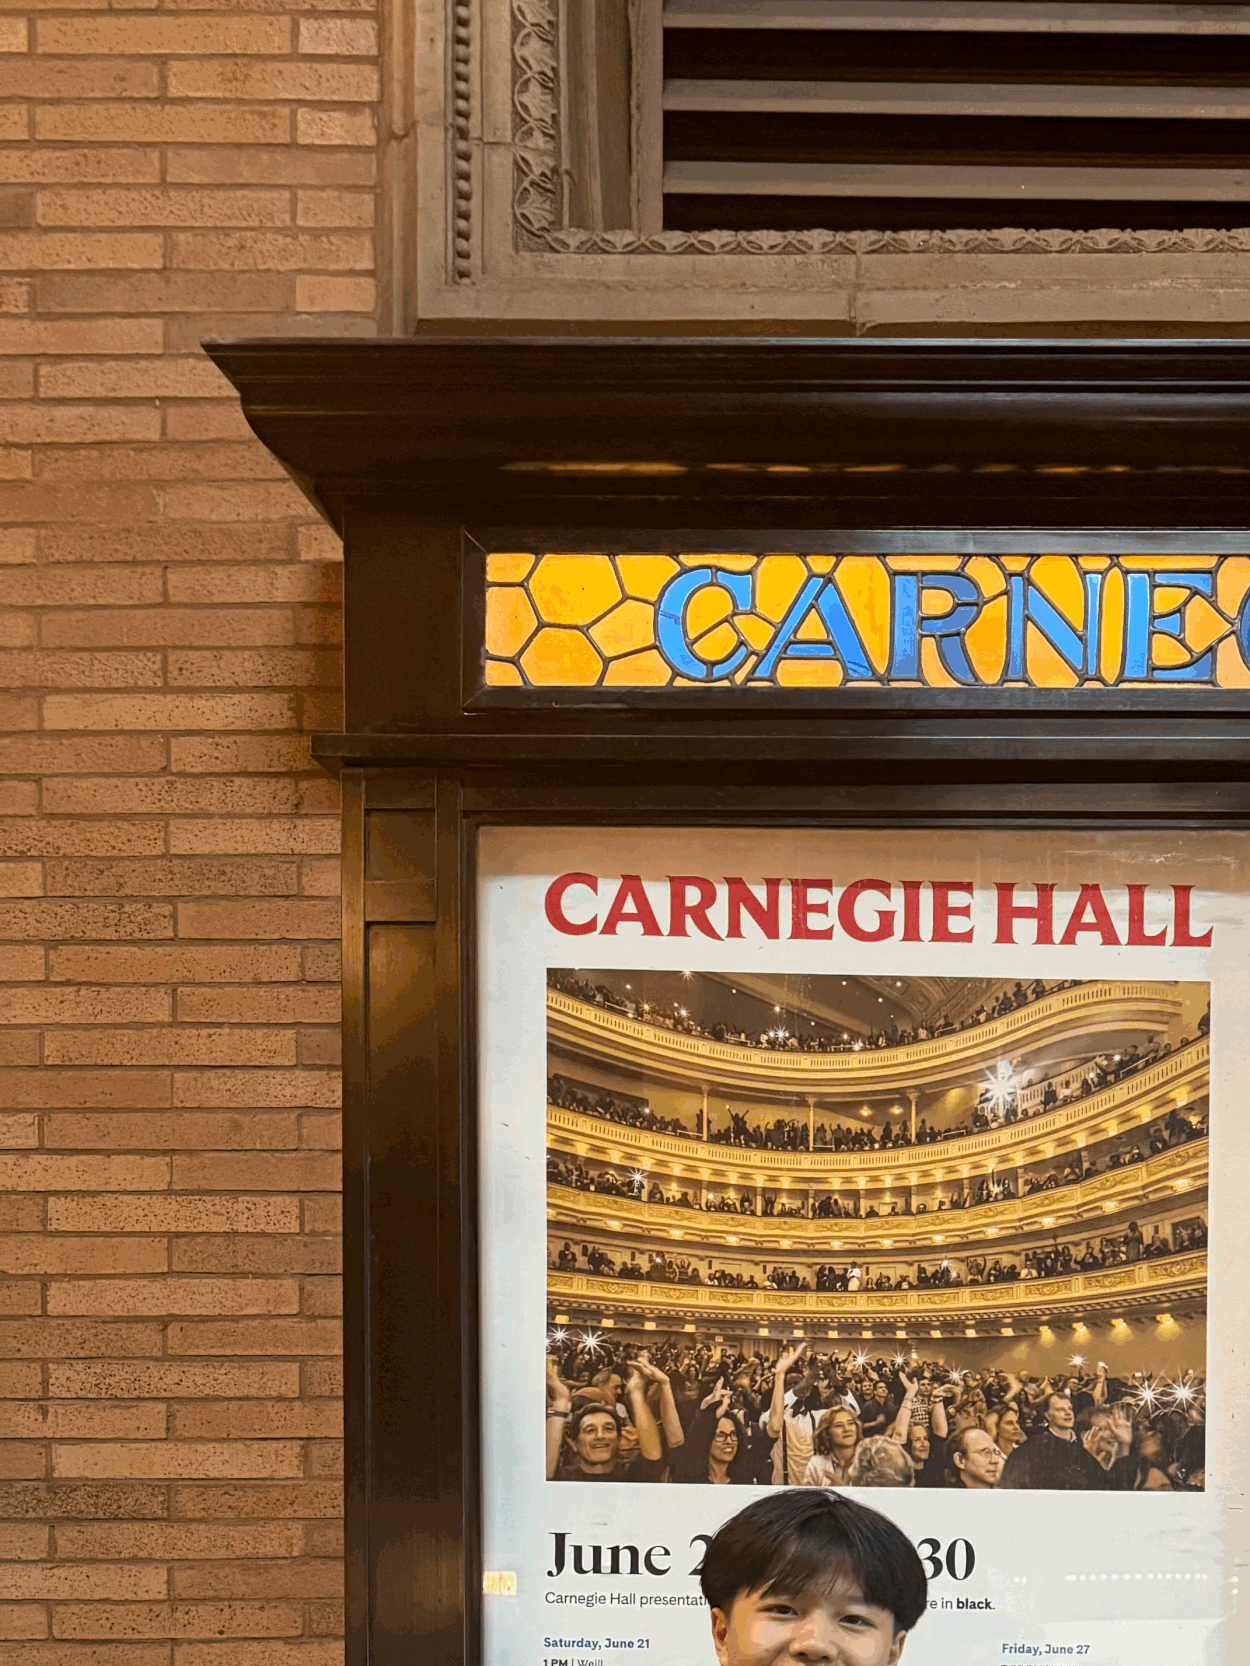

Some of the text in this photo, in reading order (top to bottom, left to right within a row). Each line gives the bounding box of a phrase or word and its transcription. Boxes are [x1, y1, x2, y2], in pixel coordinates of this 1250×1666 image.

[545, 871, 1213, 947] CARNEGIE HALL
[547, 1532, 672, 1578] June
[916, 1537, 976, 1581] 30
[544, 1591, 710, 1611] Carnegie Hall presentati
[925, 1597, 996, 1610] re in black.
[543, 1636, 650, 1651] Saturday, June 21
[1001, 1642, 1091, 1657] Friday, June 27
